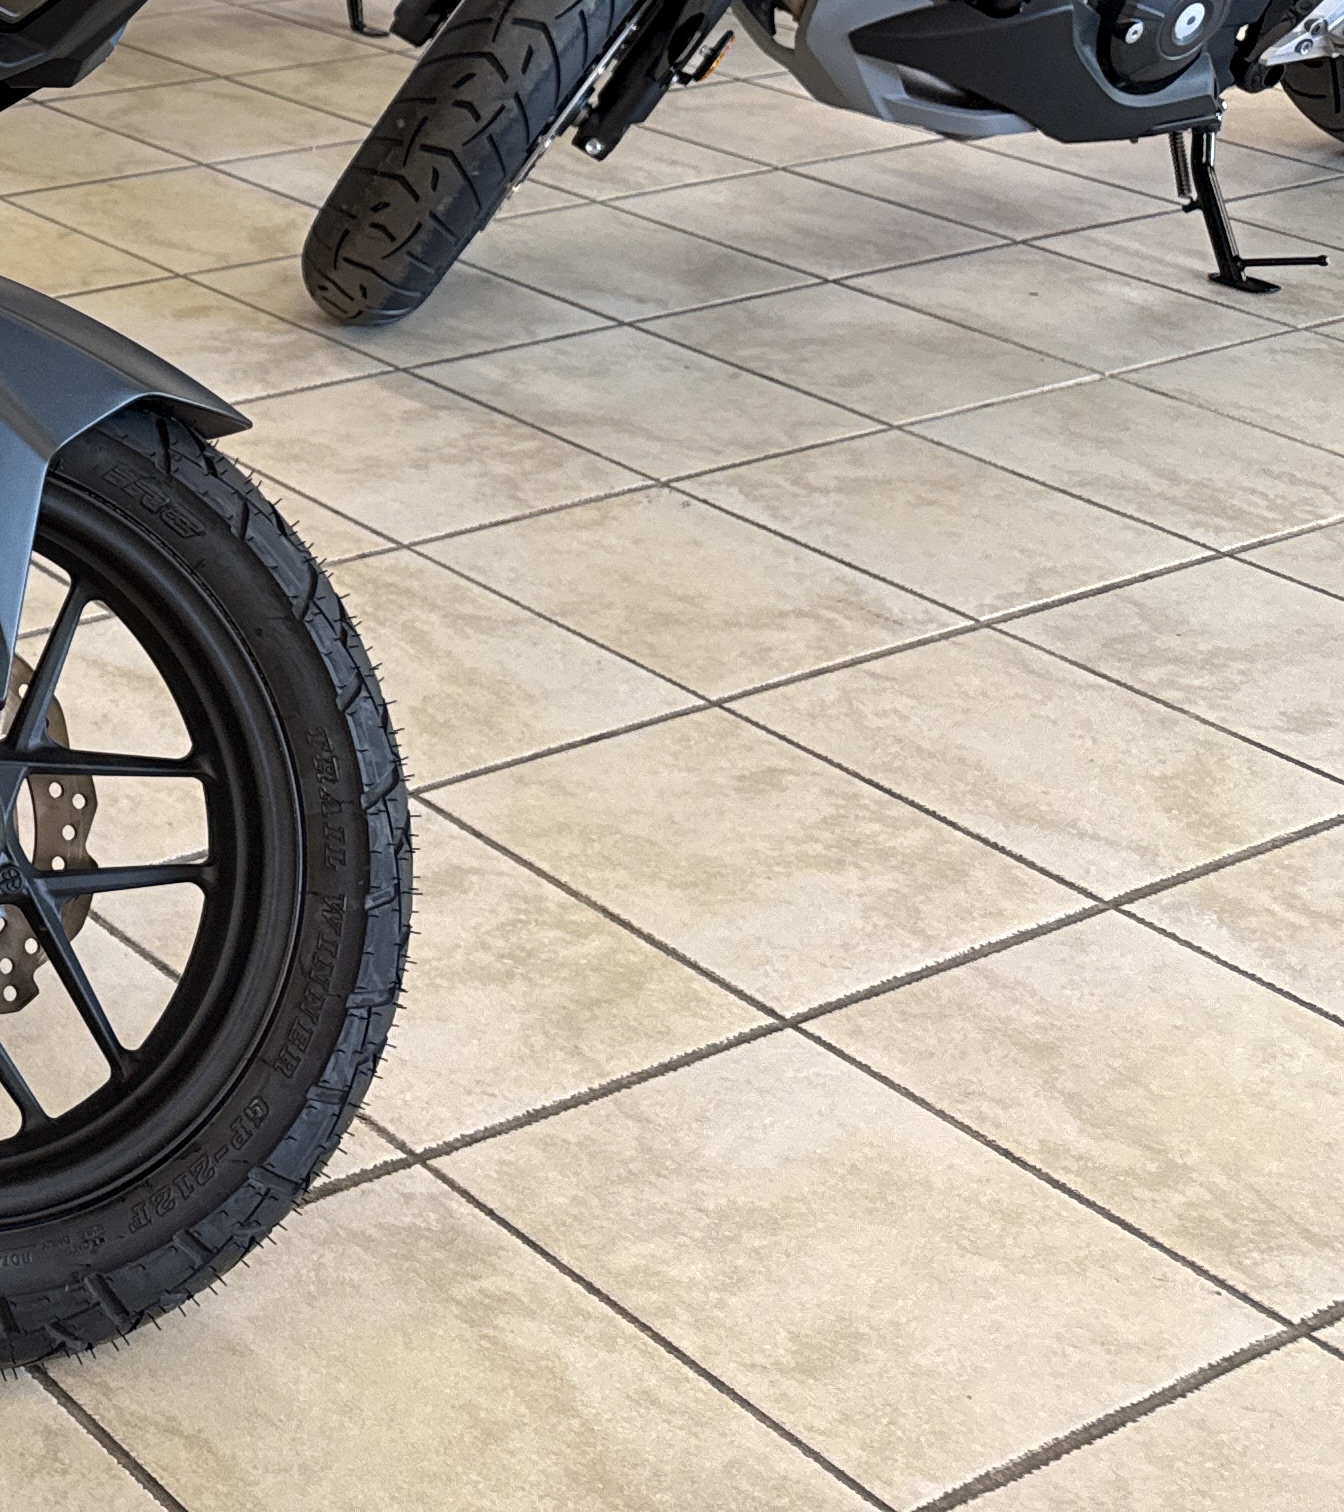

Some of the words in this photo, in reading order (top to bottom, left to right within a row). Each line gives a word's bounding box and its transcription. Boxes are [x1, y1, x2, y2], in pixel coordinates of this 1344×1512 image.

[306, 726, 347, 871] TRAIL
[274, 893, 346, 1079] WINNER
[127, 1095, 270, 1235] GP-212F
